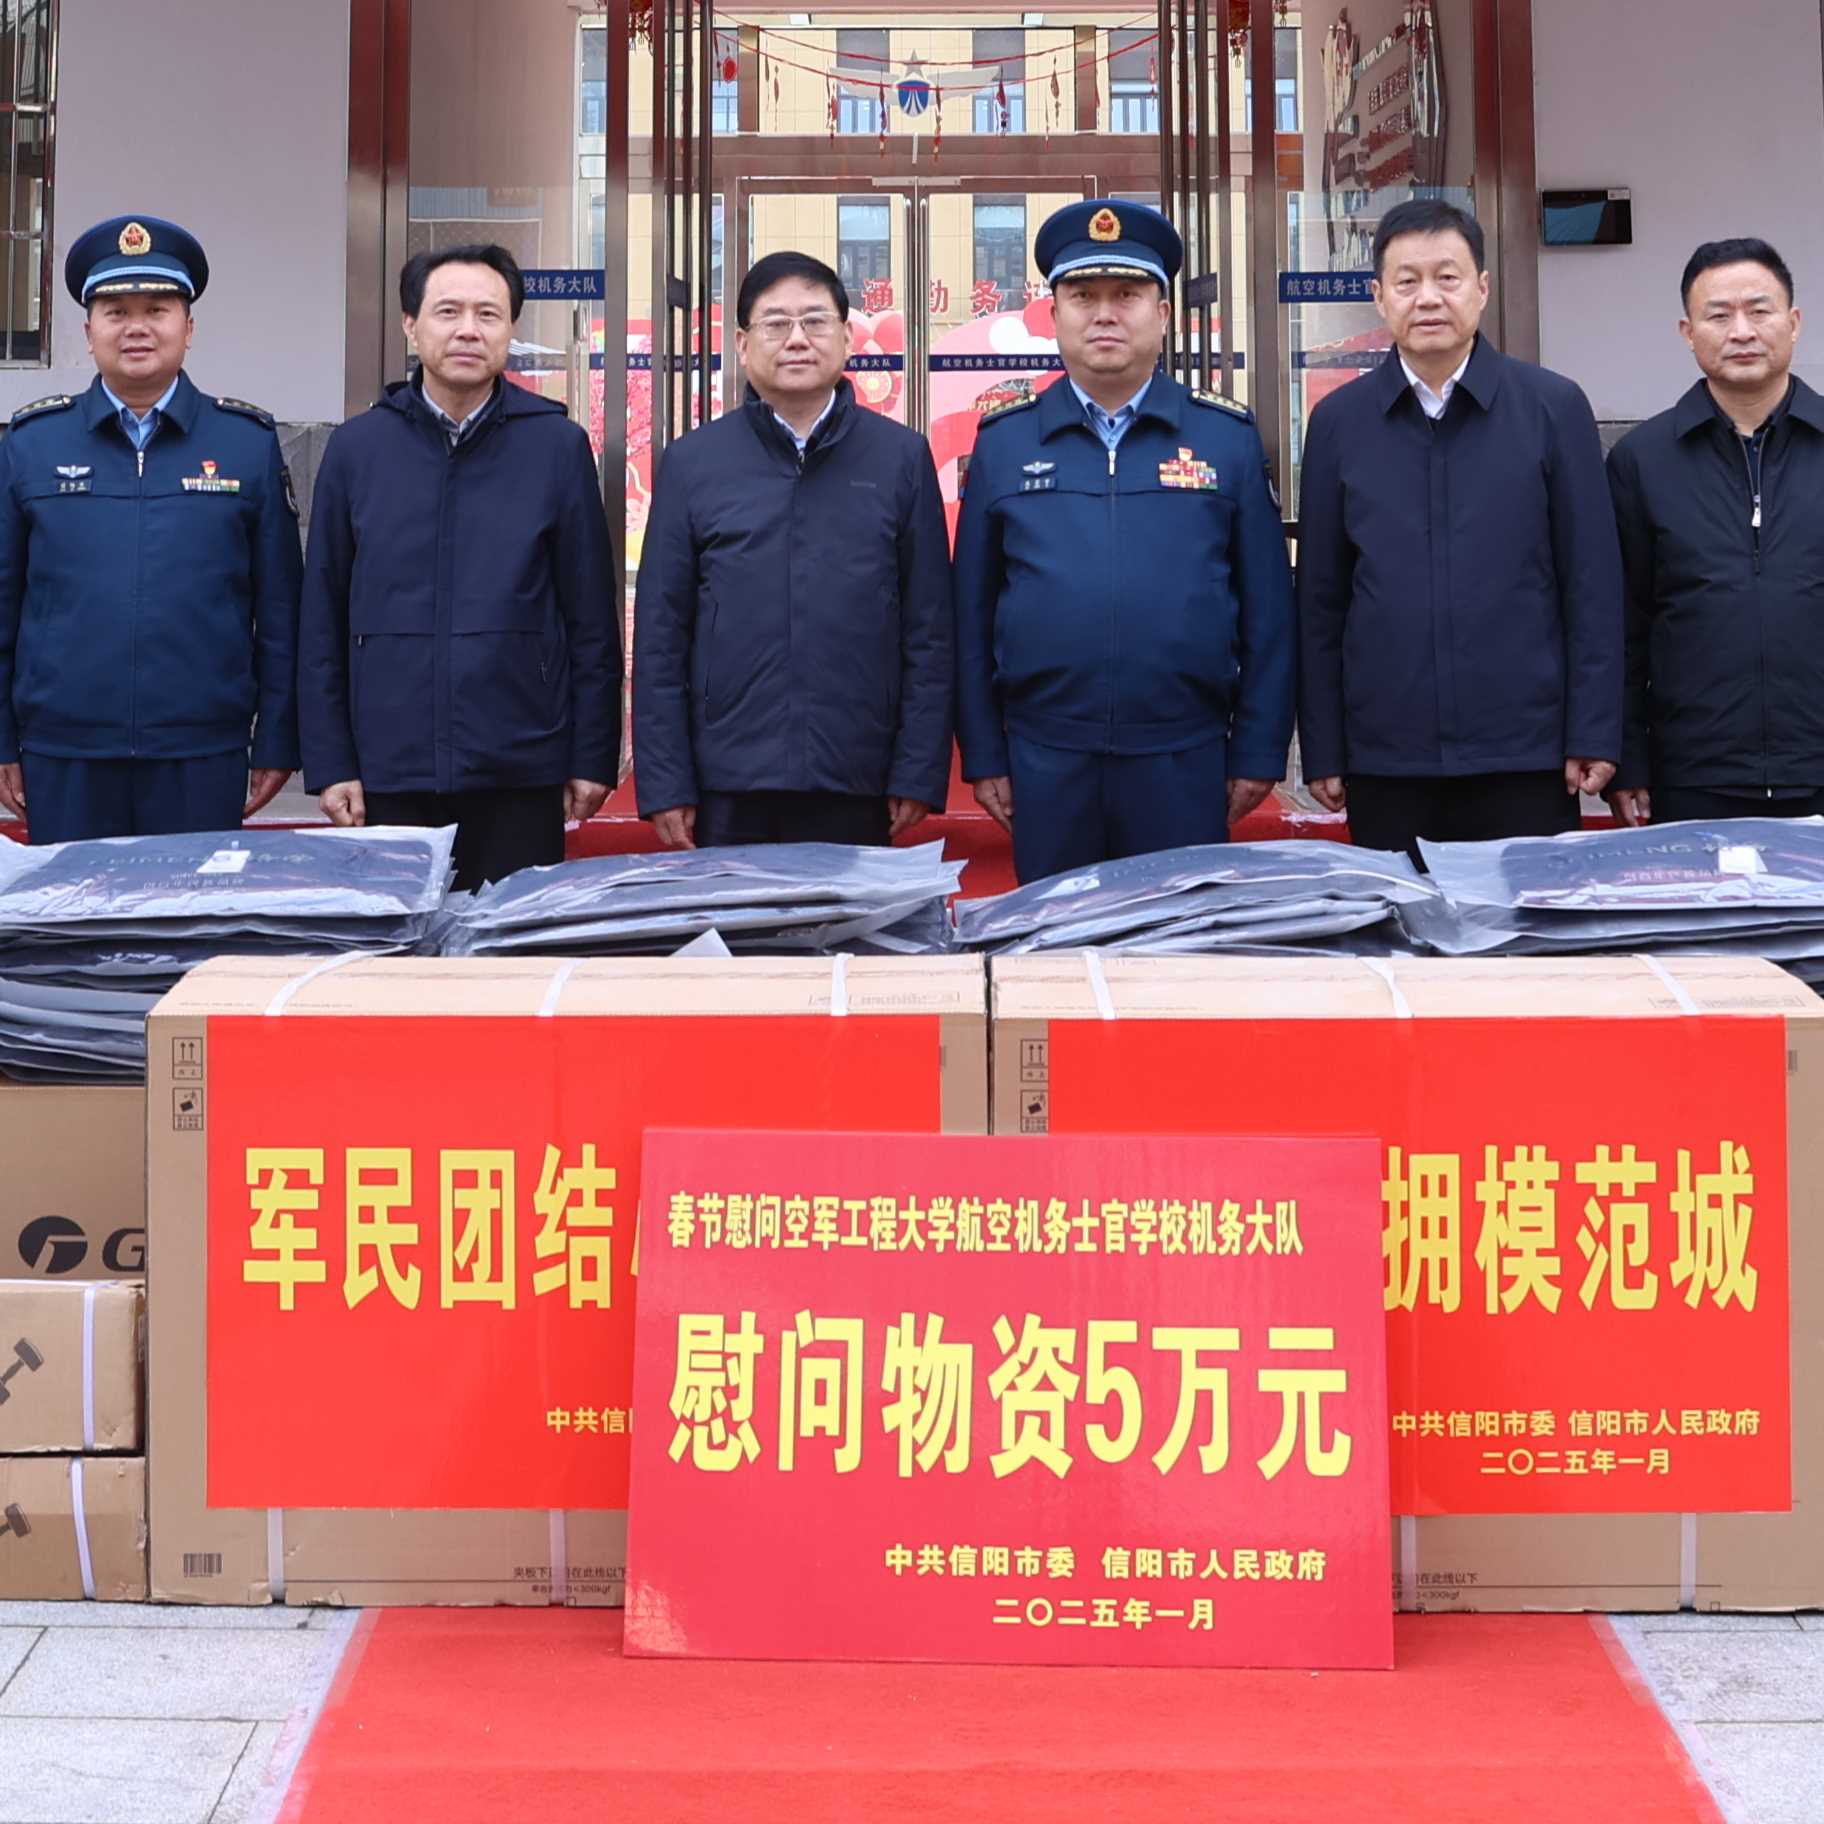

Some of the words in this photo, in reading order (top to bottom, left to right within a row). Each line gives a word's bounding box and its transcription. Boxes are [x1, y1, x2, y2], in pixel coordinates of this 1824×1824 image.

[243, 1142, 641, 1311] 军民团结
[667, 1190, 1304, 1257] 春节慰问空军工程大学航空机务士官学校机务大队
[1381, 1140, 1758, 1314] 拥模范城
[546, 1406, 634, 1434] 中共信
[668, 1310, 1353, 1480] 慰问物资5万元
[1392, 1409, 1556, 1437] 中共信阳市委
[1567, 1408, 1761, 1437] 信阳市人民政府
[885, 1543, 1076, 1579] 中共信阳市委
[1102, 1545, 1327, 1582] 信阳市人民政府
